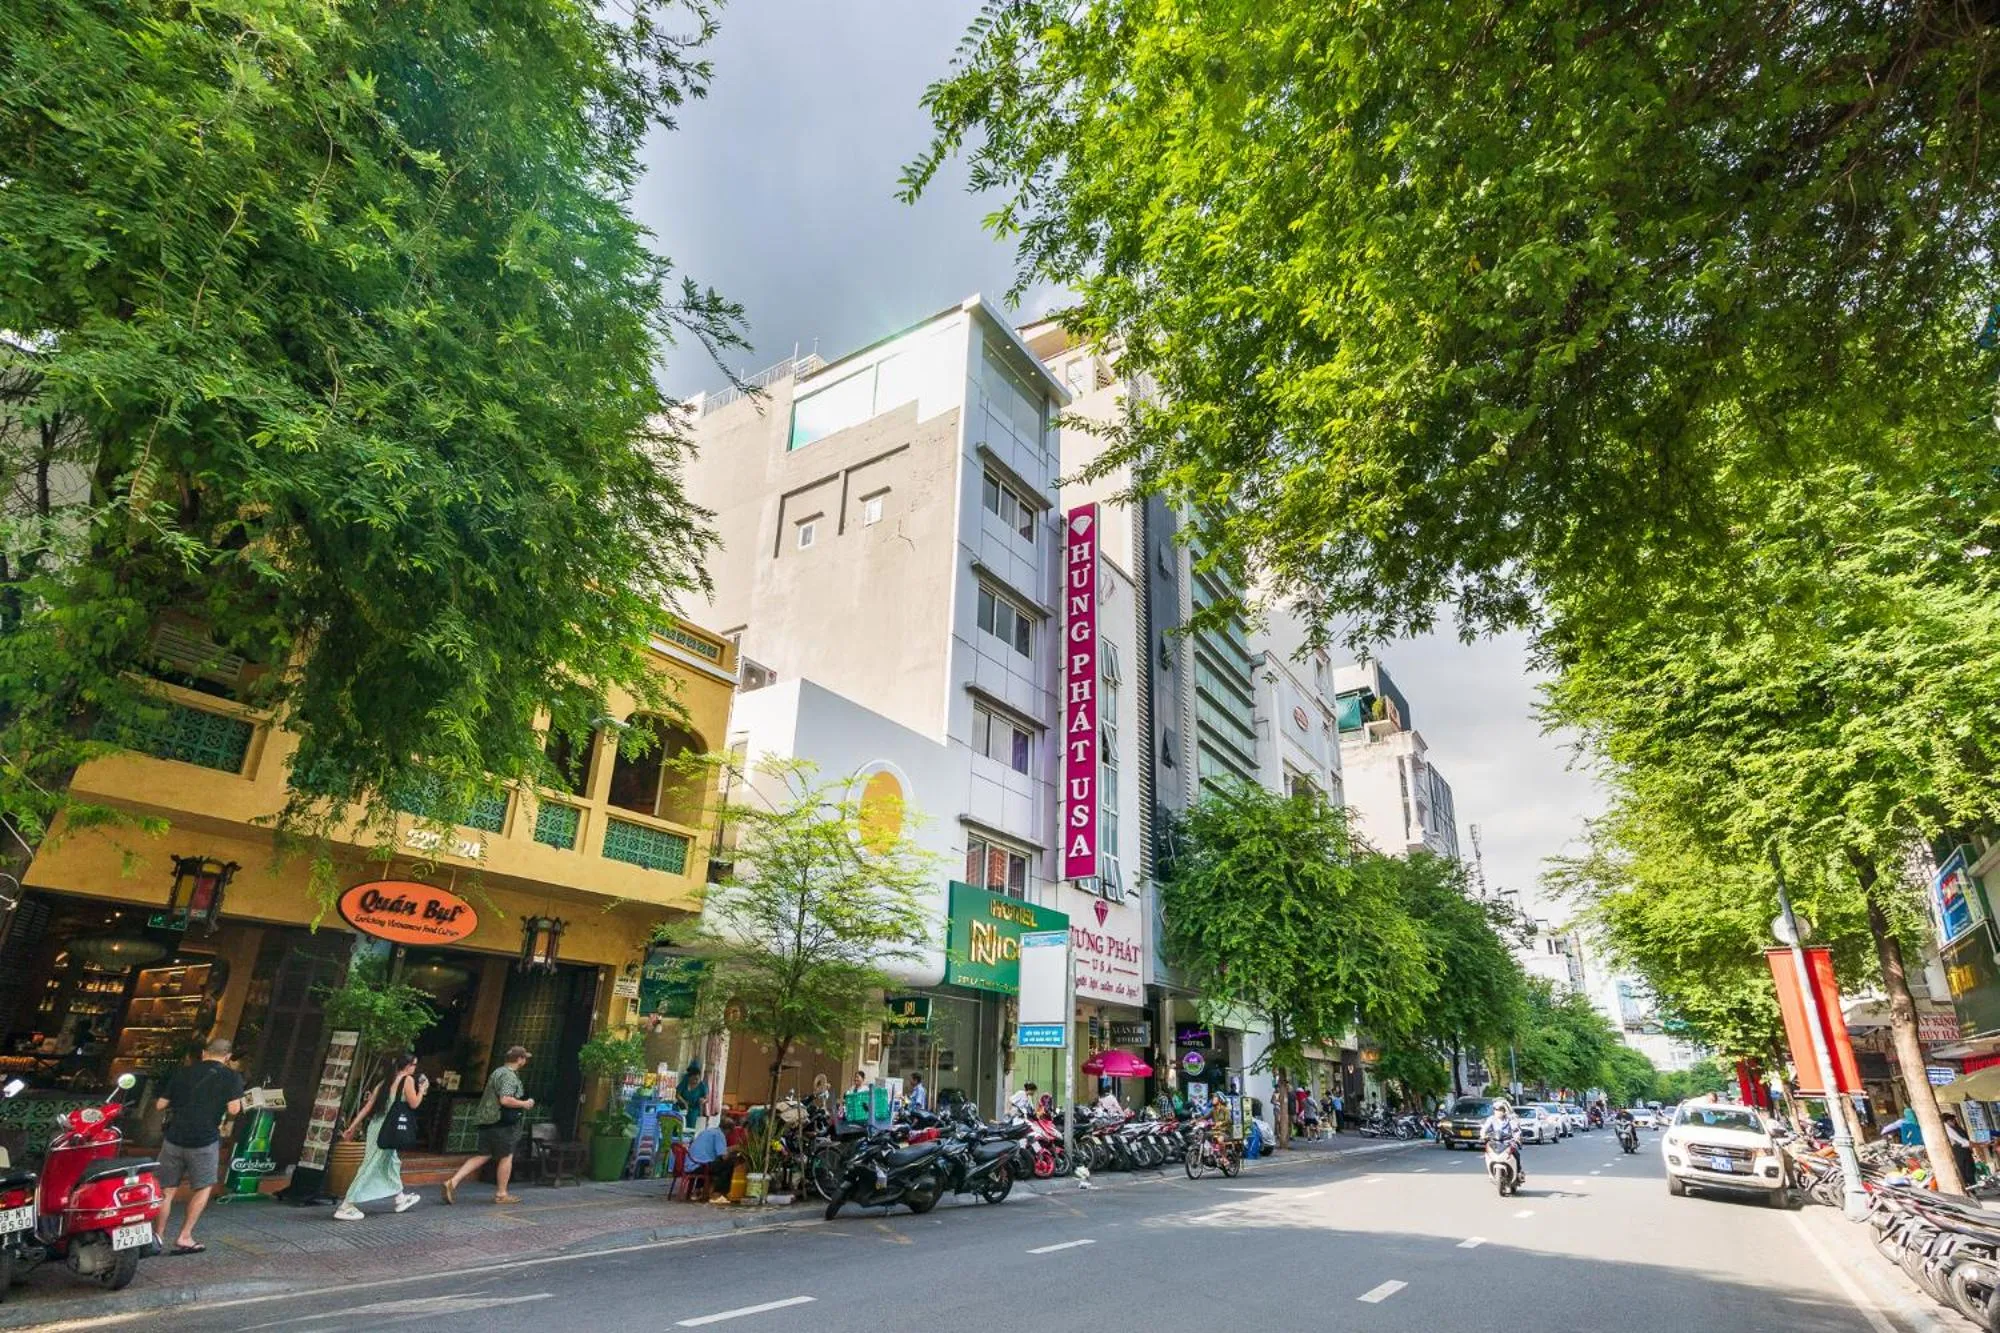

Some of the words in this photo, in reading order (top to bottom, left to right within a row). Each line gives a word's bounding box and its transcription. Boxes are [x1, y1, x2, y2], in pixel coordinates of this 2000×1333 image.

[1070, 541, 1091, 643] HƯNG
[1069, 653, 1092, 763] PHÁT
[1068, 777, 1092, 858] USA
[360, 889, 418, 916] Quán
[991, 899, 1037, 927] HOTEL
[354, 914, 385, 928] Enriching
[1106, 936, 1142, 963] PHÁT
[1092, 958, 1112, 973] USA
[231, 1157, 276, 1172] Carlsberg
